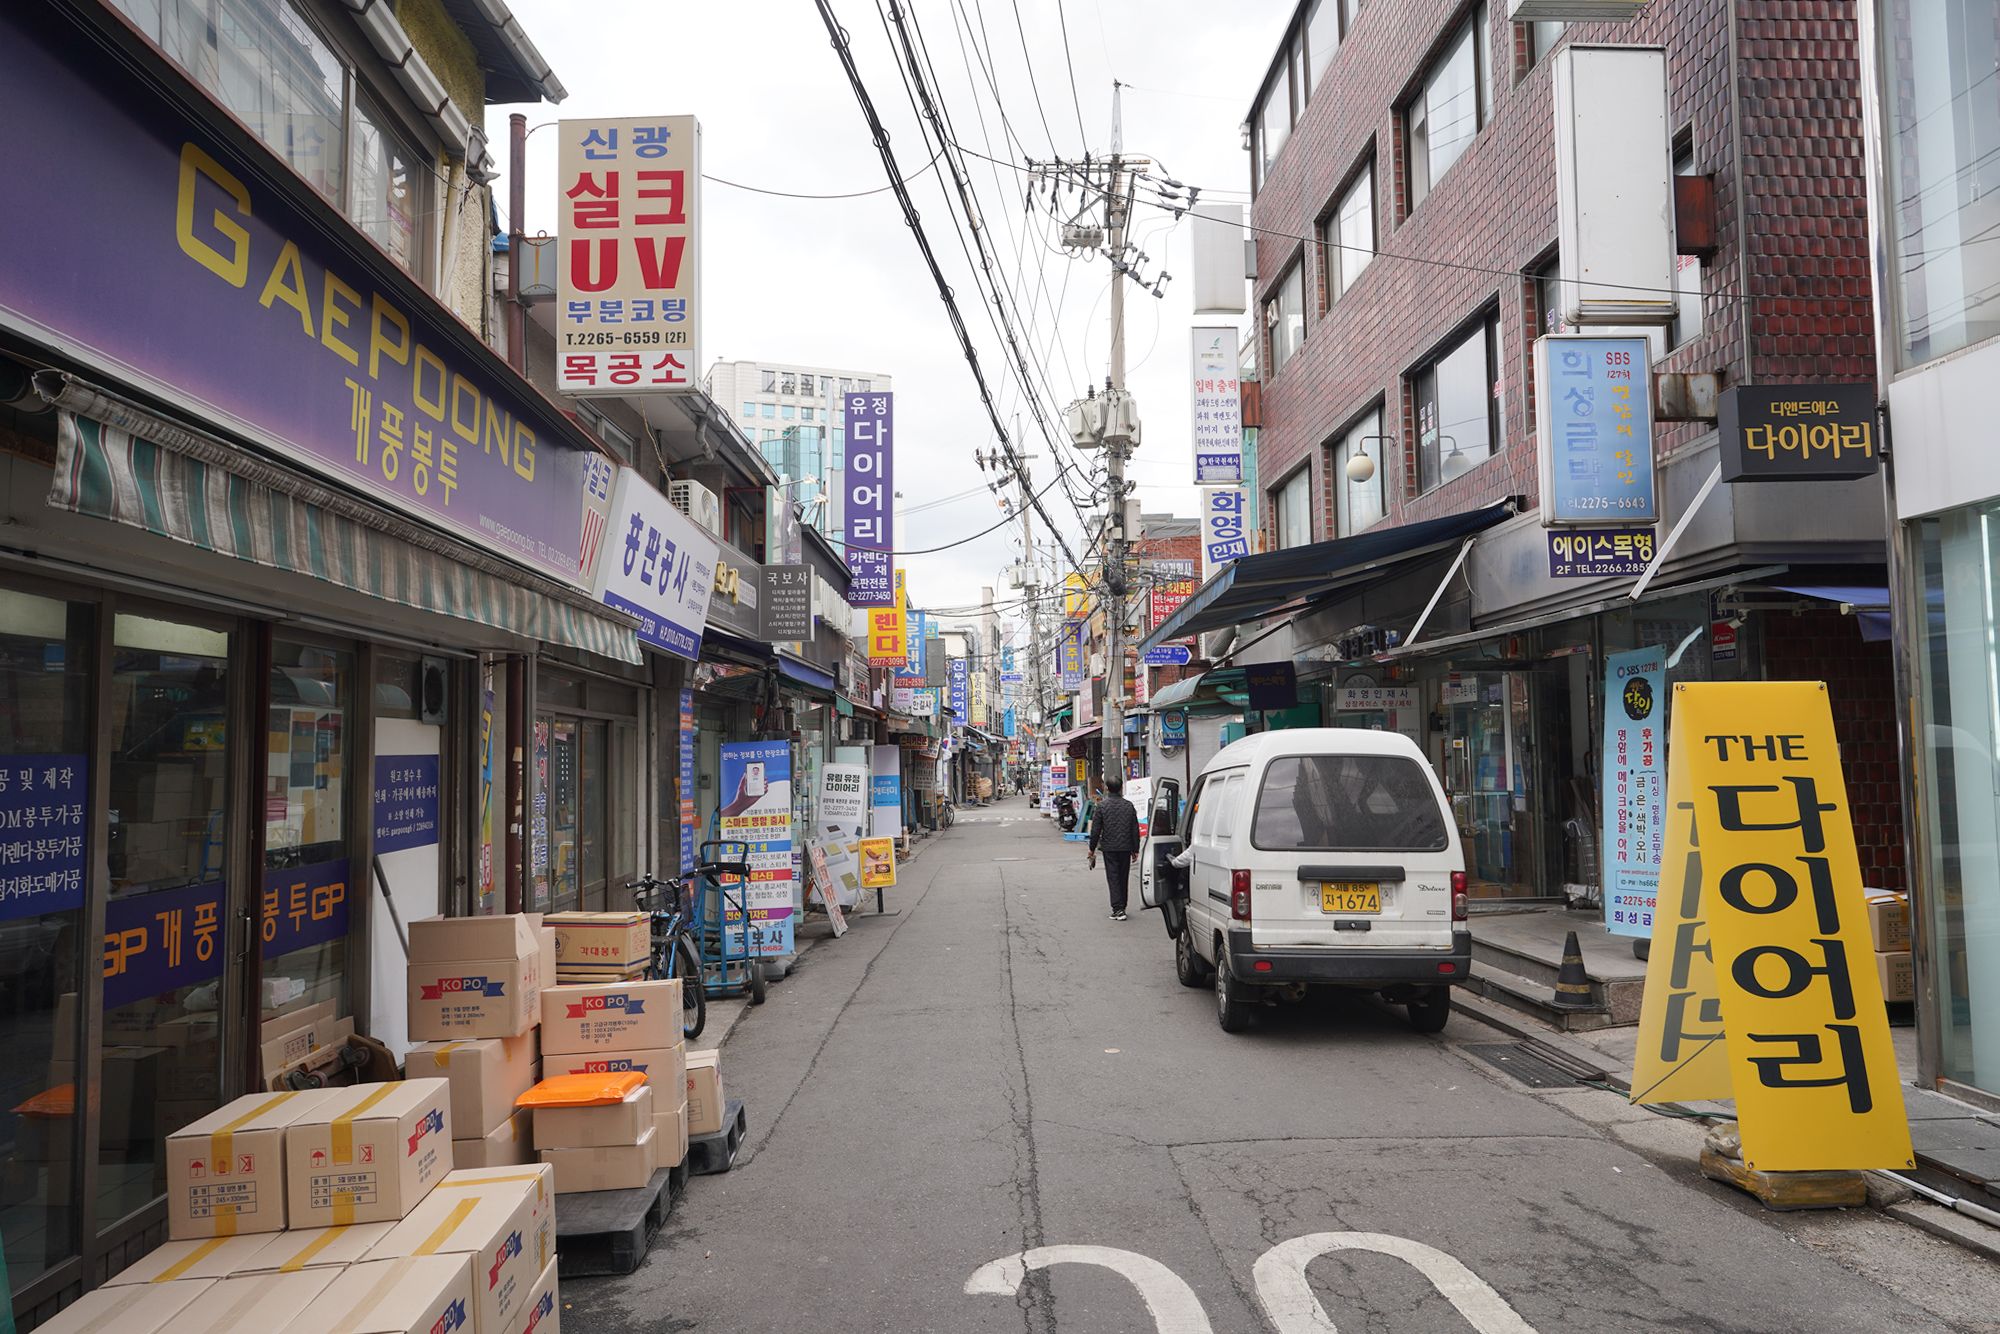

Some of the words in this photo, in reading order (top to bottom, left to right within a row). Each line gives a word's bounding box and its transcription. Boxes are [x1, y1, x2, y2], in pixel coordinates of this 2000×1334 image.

[580, 127, 671, 160] 신광
[565, 170, 686, 229] 실크
[570, 236, 686, 292] UV
[176, 142, 535, 482] GAEPOONG
[567, 299, 687, 323] 부분코팅
[566, 331, 660, 346] T.2265-6559
[563, 353, 687, 386] 목공소
[1606, 352, 1630, 365] SBS
[1196, 379, 1214, 393] 입력
[1217, 379, 1237, 392] 출력
[850, 397, 888, 416] 유정
[1770, 401, 1839, 416] 디앤드에스
[344, 377, 458, 506] 개풍봉투
[1744, 421, 1872, 460] 다이어리
[853, 419, 888, 544] 다이어리
[1564, 497, 1645, 509] el.2275-6643
[1211, 492, 1245, 538] 화영
[579, 508, 604, 576] UV
[1212, 541, 1245, 559] 인재
[1553, 533, 1653, 562] 에이스목형
[850, 552, 889, 564] 카렌다
[767, 572, 807, 586] 국보사
[1556, 565, 1571, 574] 2F
[848, 591, 891, 602] 02-2277-3450
[1626, 665, 1640, 676] SBS
[1641, 662, 1658, 673] 127회
[1348, 690, 1408, 699] 화영인재사
[1625, 691, 1650, 713] 달인
[1642, 728, 1653, 767] 후가공
[1704, 735, 1809, 762] THE
[20, 768, 33, 791] 및
[42, 767, 74, 790] 제작
[826, 783, 859, 793] 다이어리
[725, 818, 749, 828] 스마트
[751, 816, 767, 827] 명함
[770, 815, 785, 826] 출시
[312, 882, 344, 921] GP
[1325, 895, 1334, 905] 자
[1338, 894, 1377, 910] 1674
[156, 902, 218, 968] 개풍
[1707, 776, 1873, 1114] 다이어리
[580, 946, 620, 957] 각대봉투
[442, 979, 481, 990] KOPO
[586, 997, 625, 1008] KOPO
[589, 1061, 628, 1072] KOPO
[416, 1114, 434, 1137] KOPO
[497, 1234, 514, 1266] KOPO
[531, 1296, 547, 1326] KOPO
